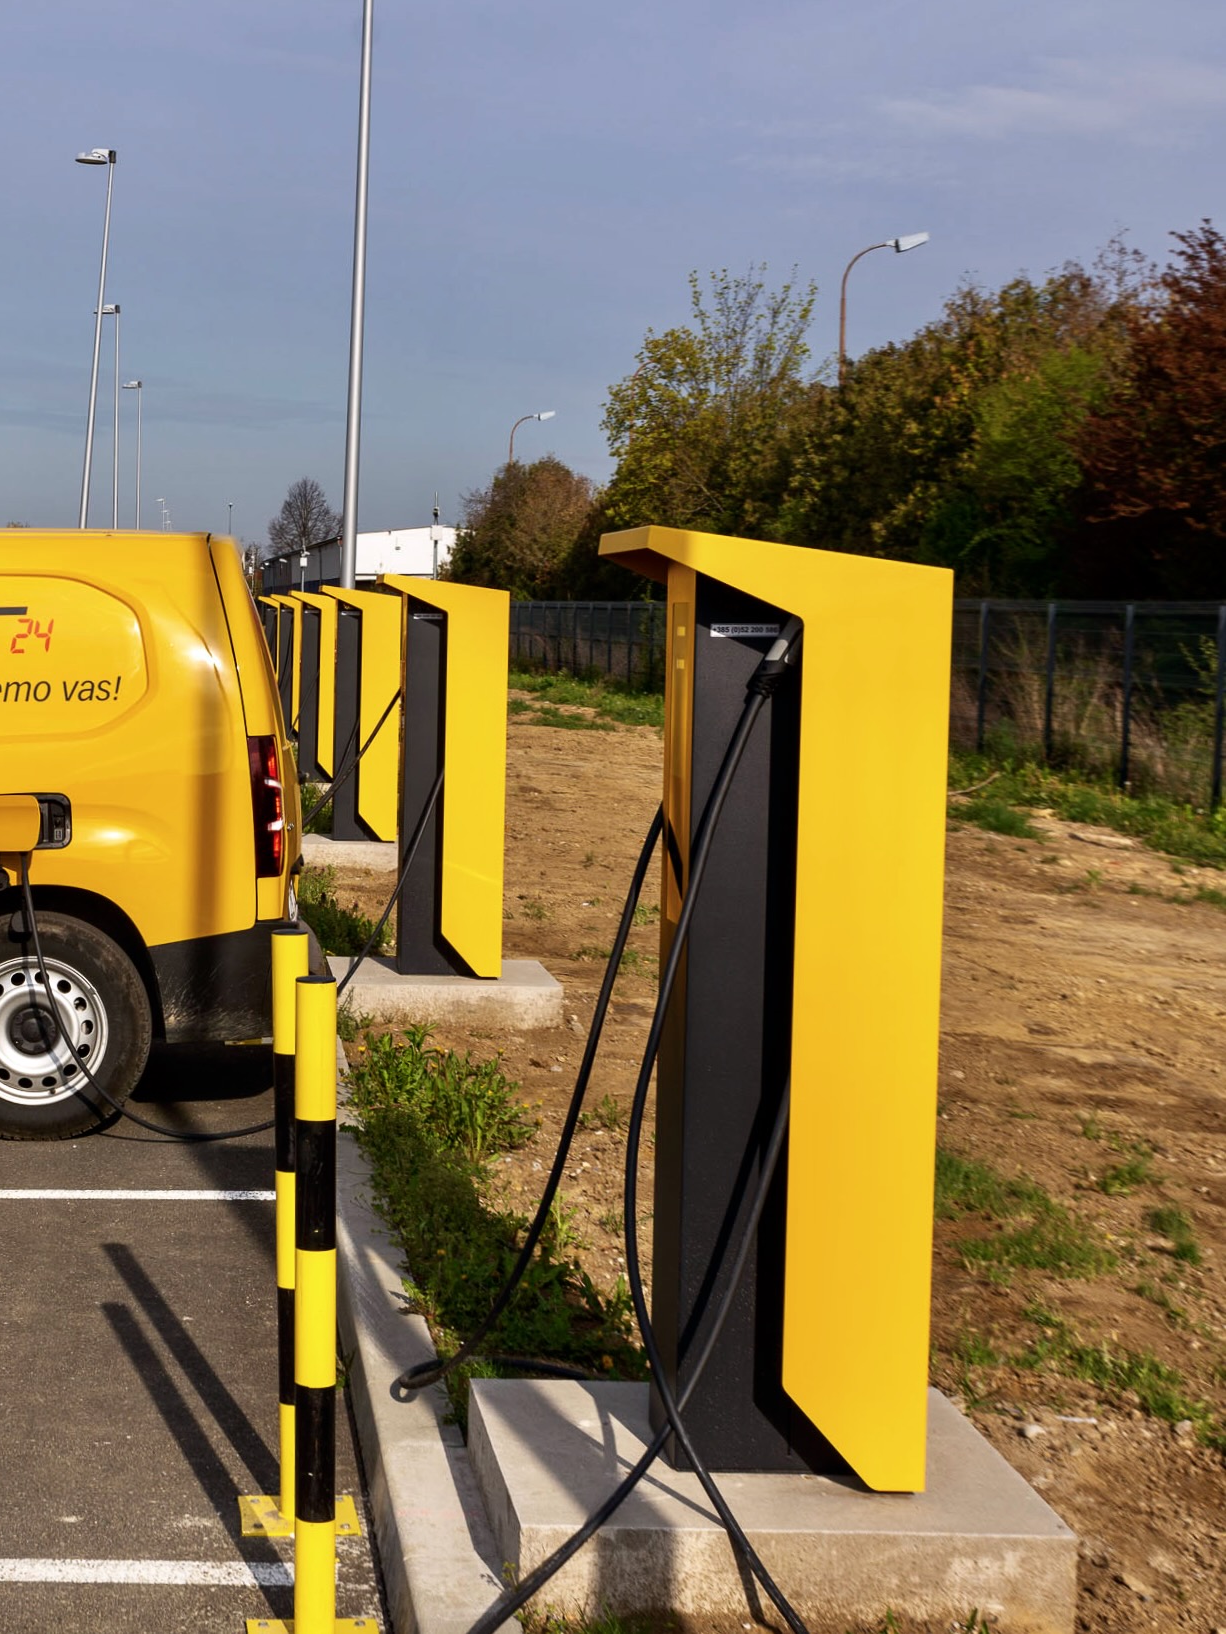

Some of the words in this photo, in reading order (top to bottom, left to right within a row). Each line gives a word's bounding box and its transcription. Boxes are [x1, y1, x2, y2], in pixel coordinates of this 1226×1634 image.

[10, 618, 54, 654] 24
[731, 626, 749, 634] (0)52
[62, 676, 122, 701] vas!
